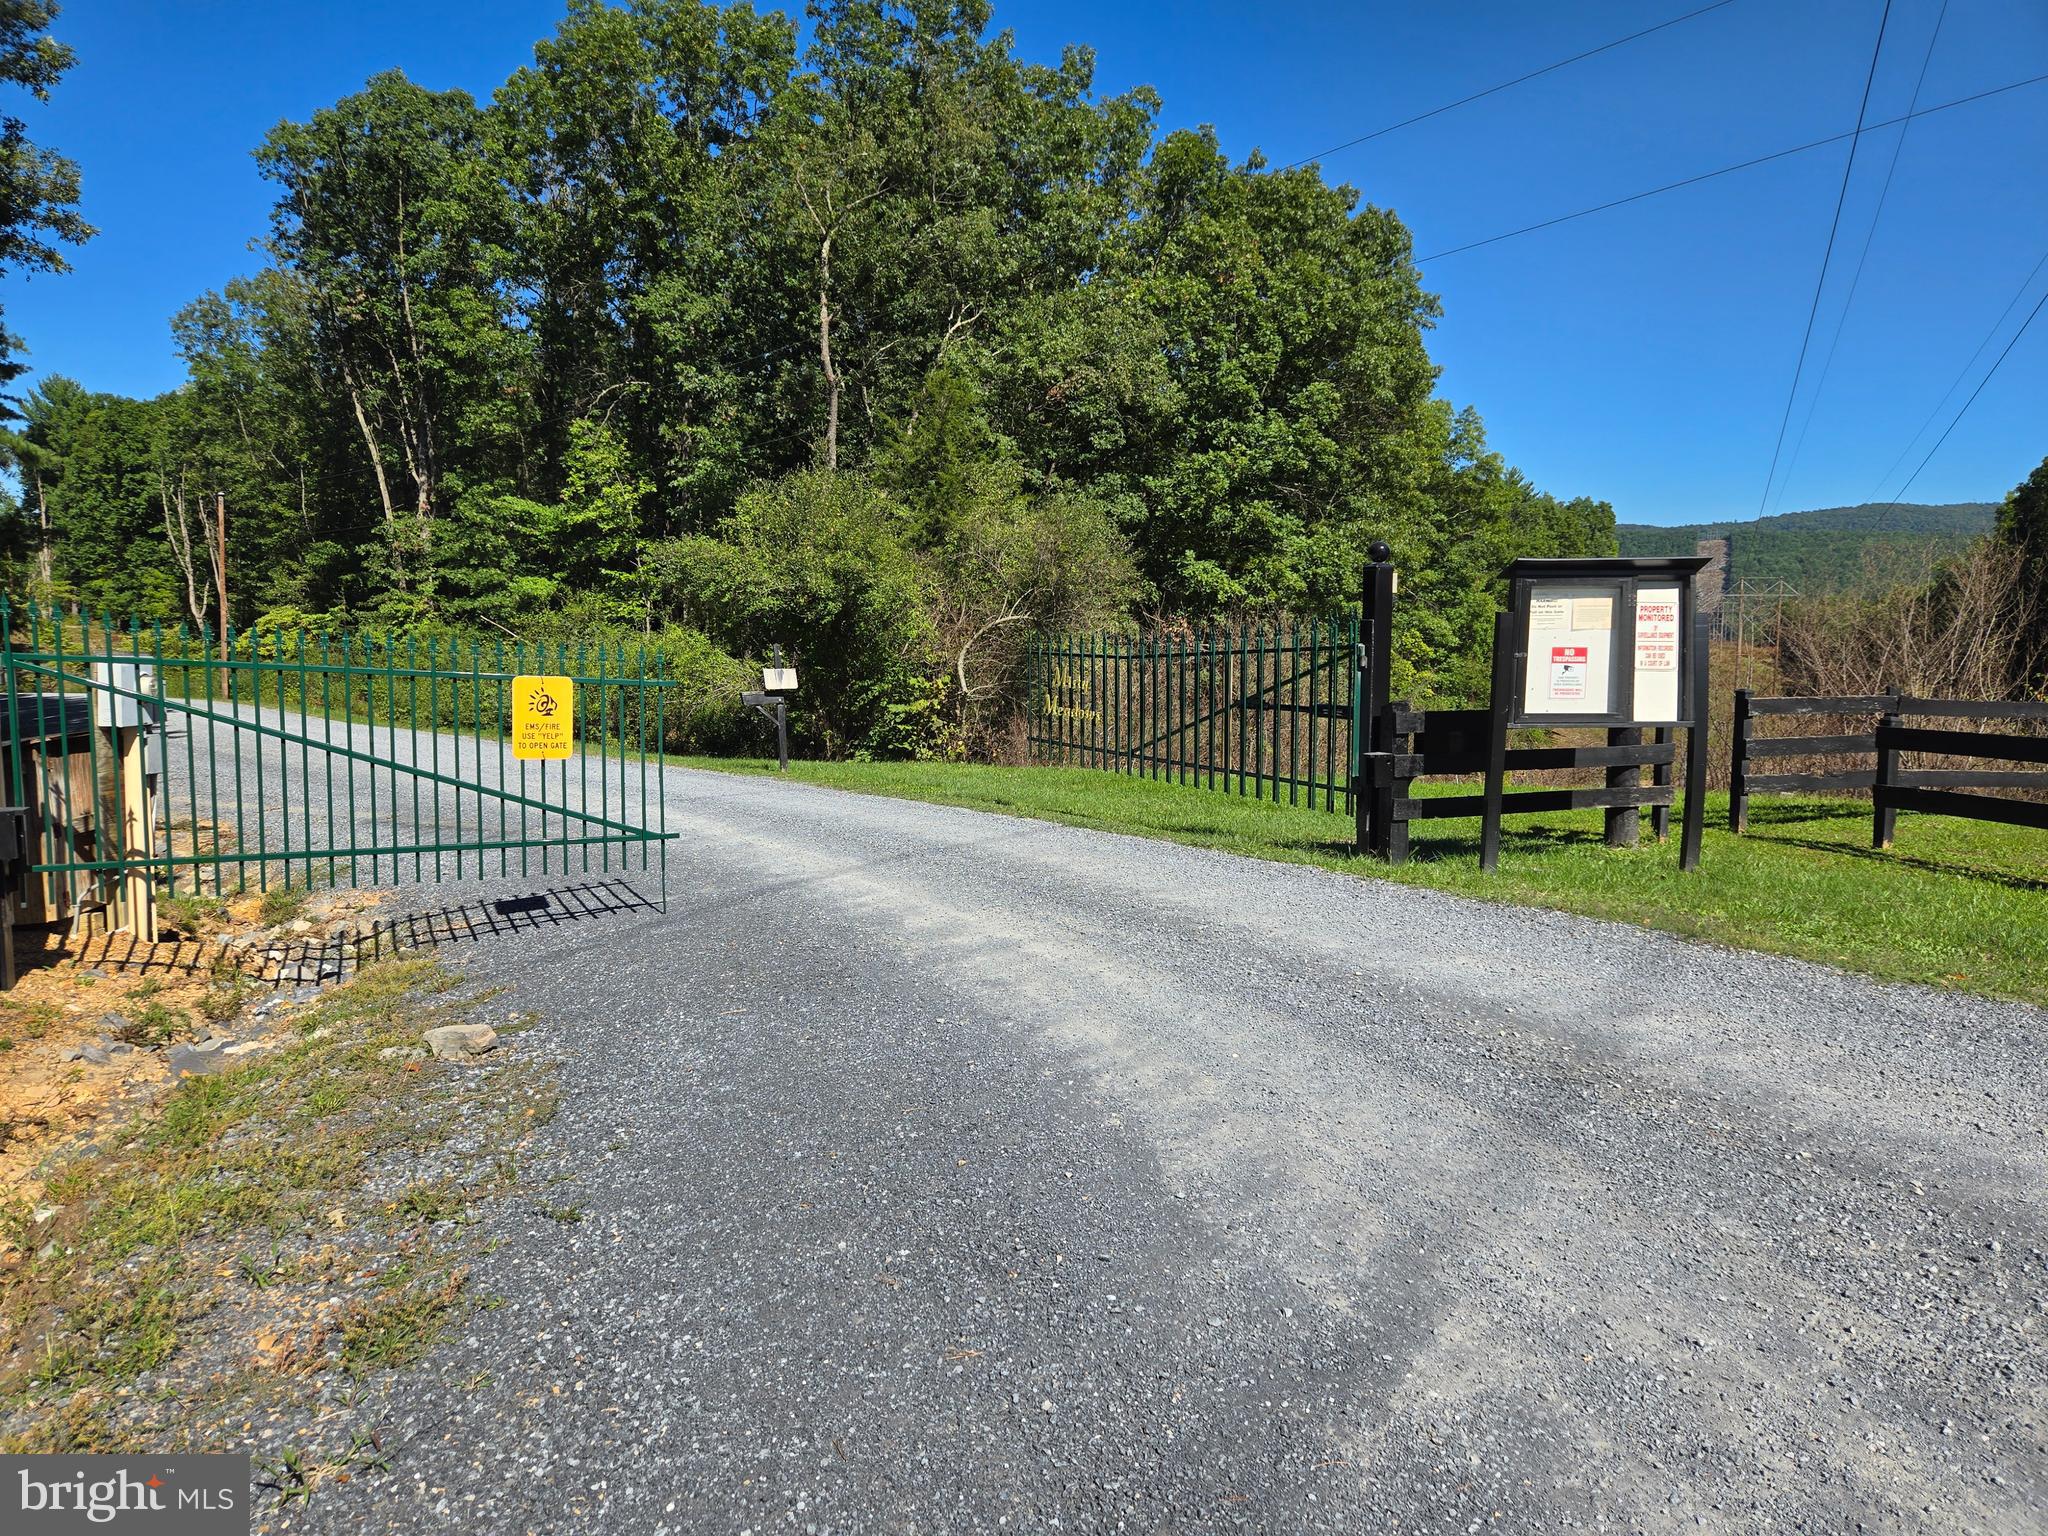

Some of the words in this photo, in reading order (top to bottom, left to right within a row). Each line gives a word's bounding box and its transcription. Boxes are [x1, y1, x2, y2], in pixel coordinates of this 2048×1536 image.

[1640, 605, 1673, 613] PROPERTY
[1564, 648, 1575, 656] NO
[525, 723, 561, 732] EMS/FIRE
[522, 732, 536, 740] USE
[538, 732, 564, 740] "YELP"
